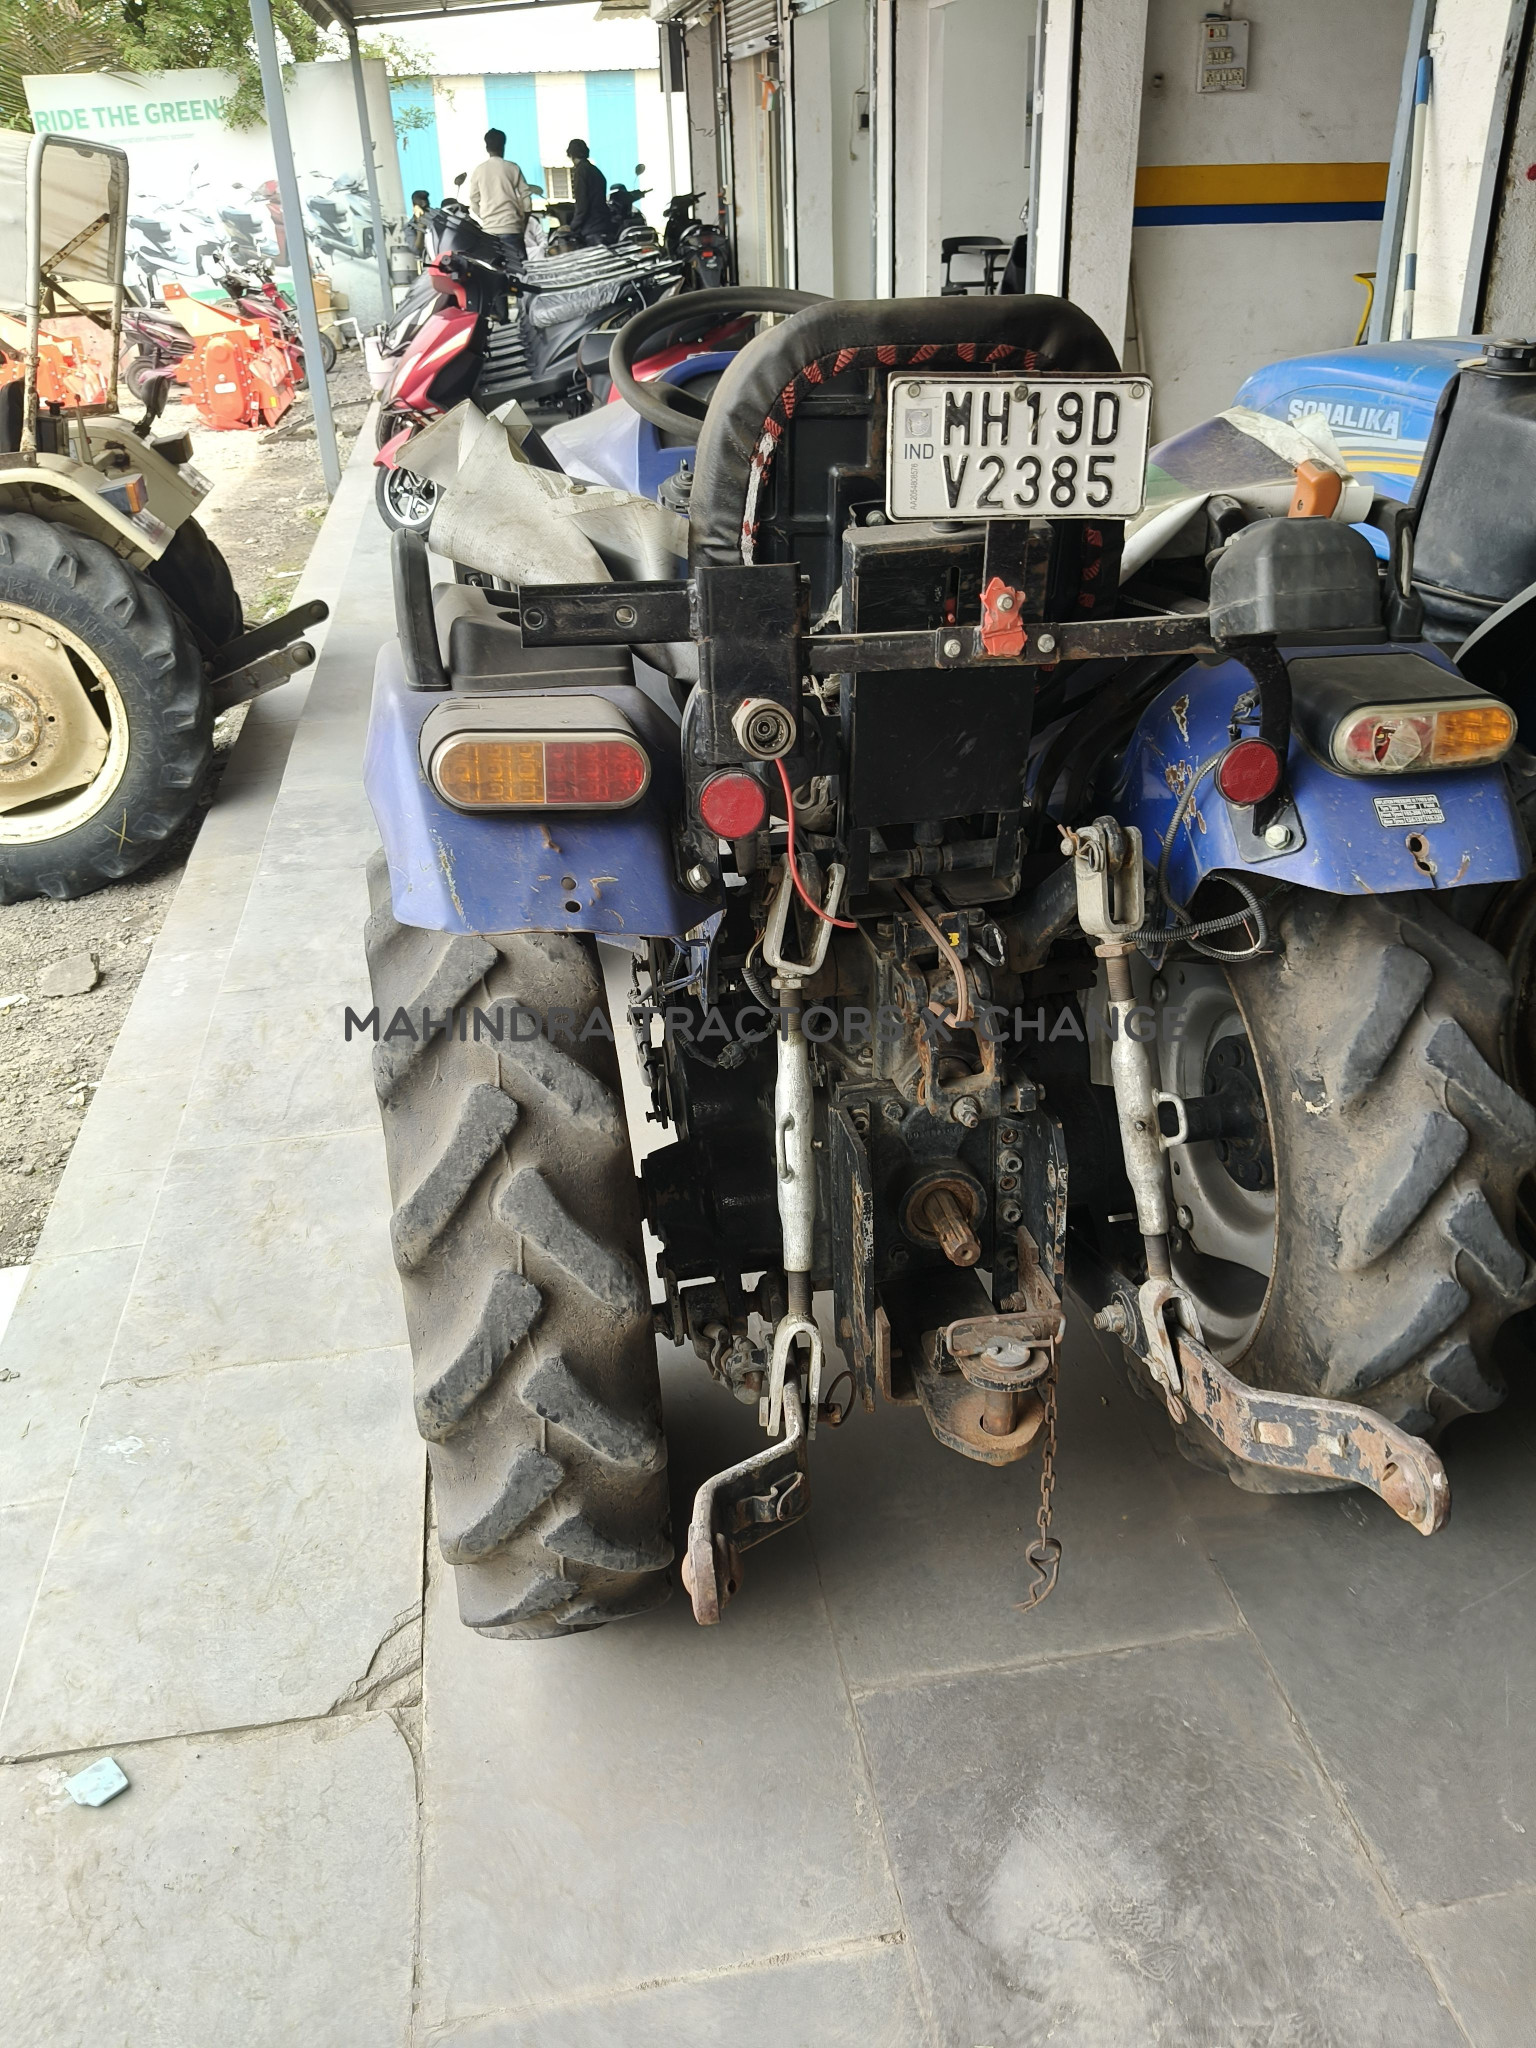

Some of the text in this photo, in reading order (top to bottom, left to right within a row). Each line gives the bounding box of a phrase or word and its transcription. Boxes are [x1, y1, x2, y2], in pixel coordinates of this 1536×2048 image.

[35, 108, 89, 132] RIDE
[92, 105, 139, 128] THE
[904, 443, 934, 460] IND
[942, 455, 1115, 509] V2385
